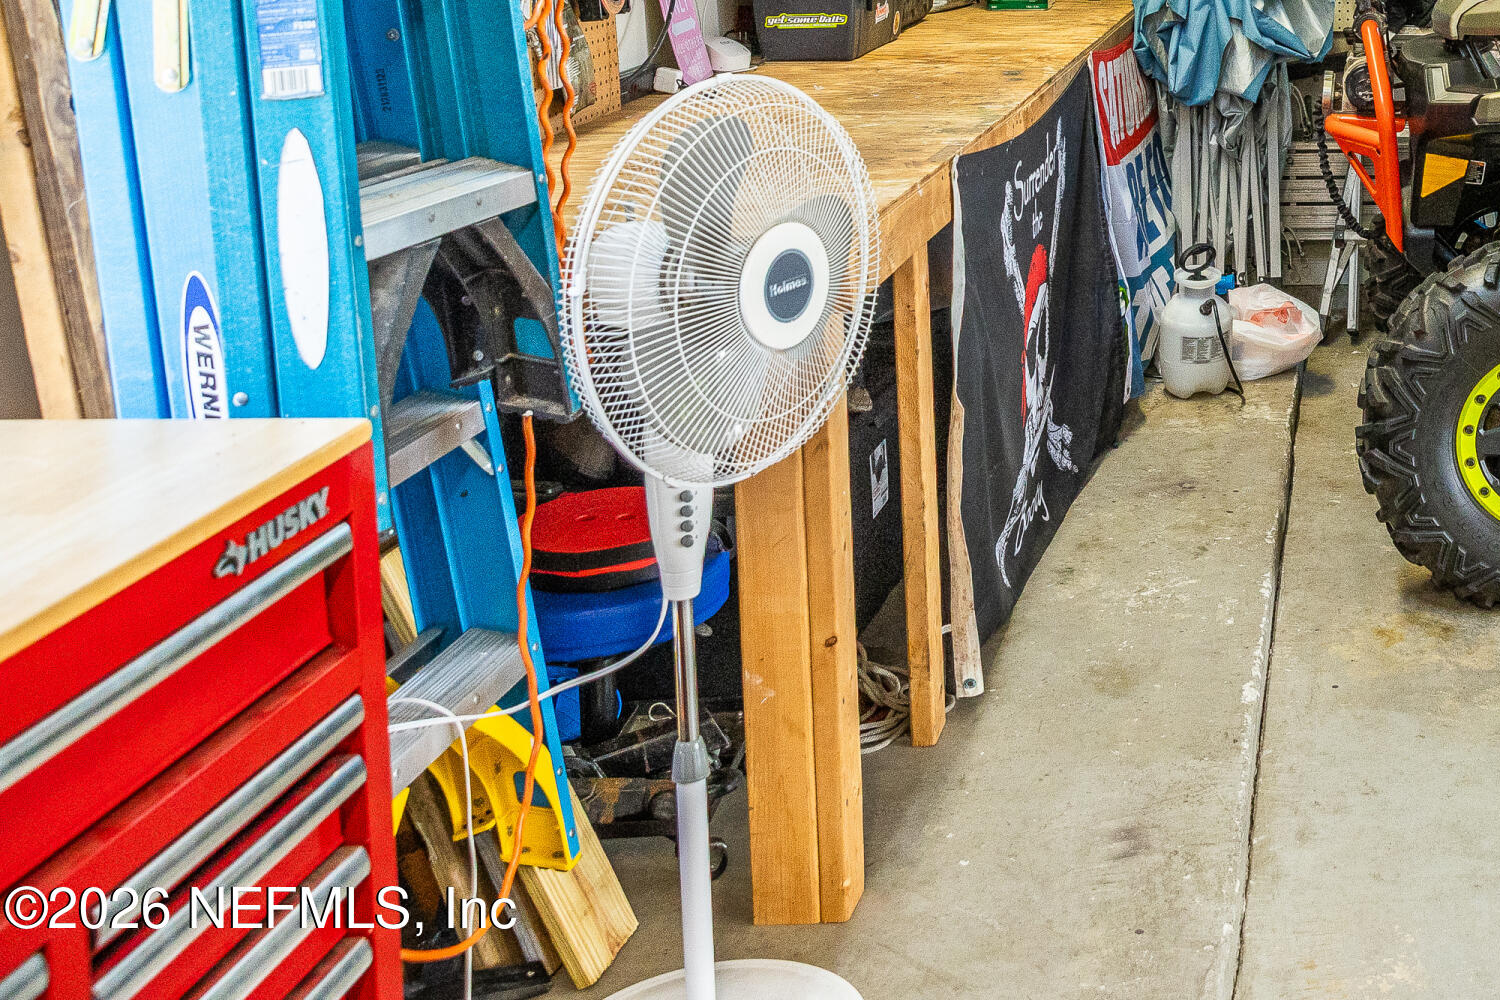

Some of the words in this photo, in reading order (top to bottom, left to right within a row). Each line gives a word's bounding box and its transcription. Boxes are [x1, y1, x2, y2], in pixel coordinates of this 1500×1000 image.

[1014, 131, 1060, 222] Surrender
[1032, 205, 1044, 239] the
[768, 276, 807, 298] Holmes
[245, 486, 331, 565] HUSKY
